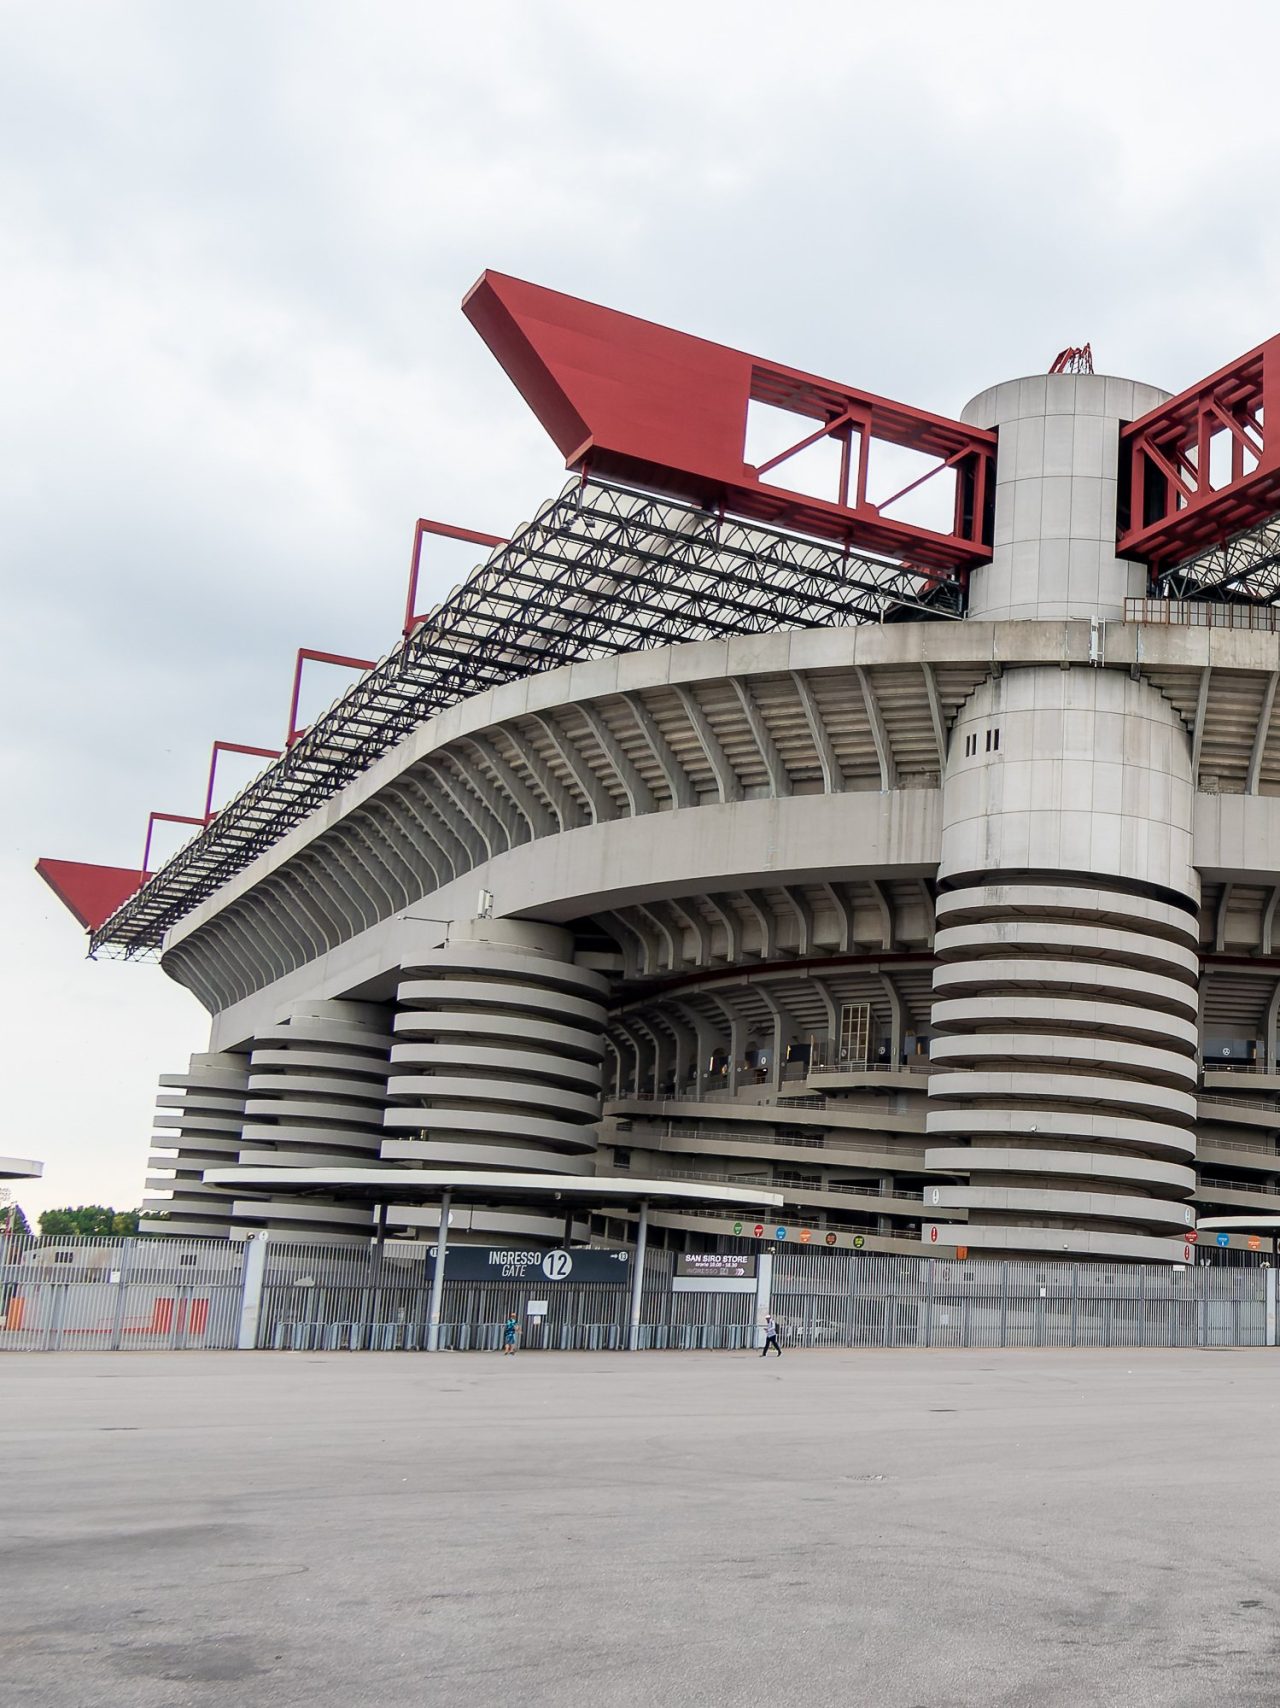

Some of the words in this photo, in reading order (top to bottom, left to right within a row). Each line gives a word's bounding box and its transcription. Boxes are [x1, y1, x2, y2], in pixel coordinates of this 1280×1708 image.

[488, 1251, 541, 1265] INGRESSO
[548, 1253, 568, 1277] 12
[685, 1254, 701, 1262] SAN
[722, 1255, 748, 1263] STORE
[501, 1264, 527, 1277] GATE
